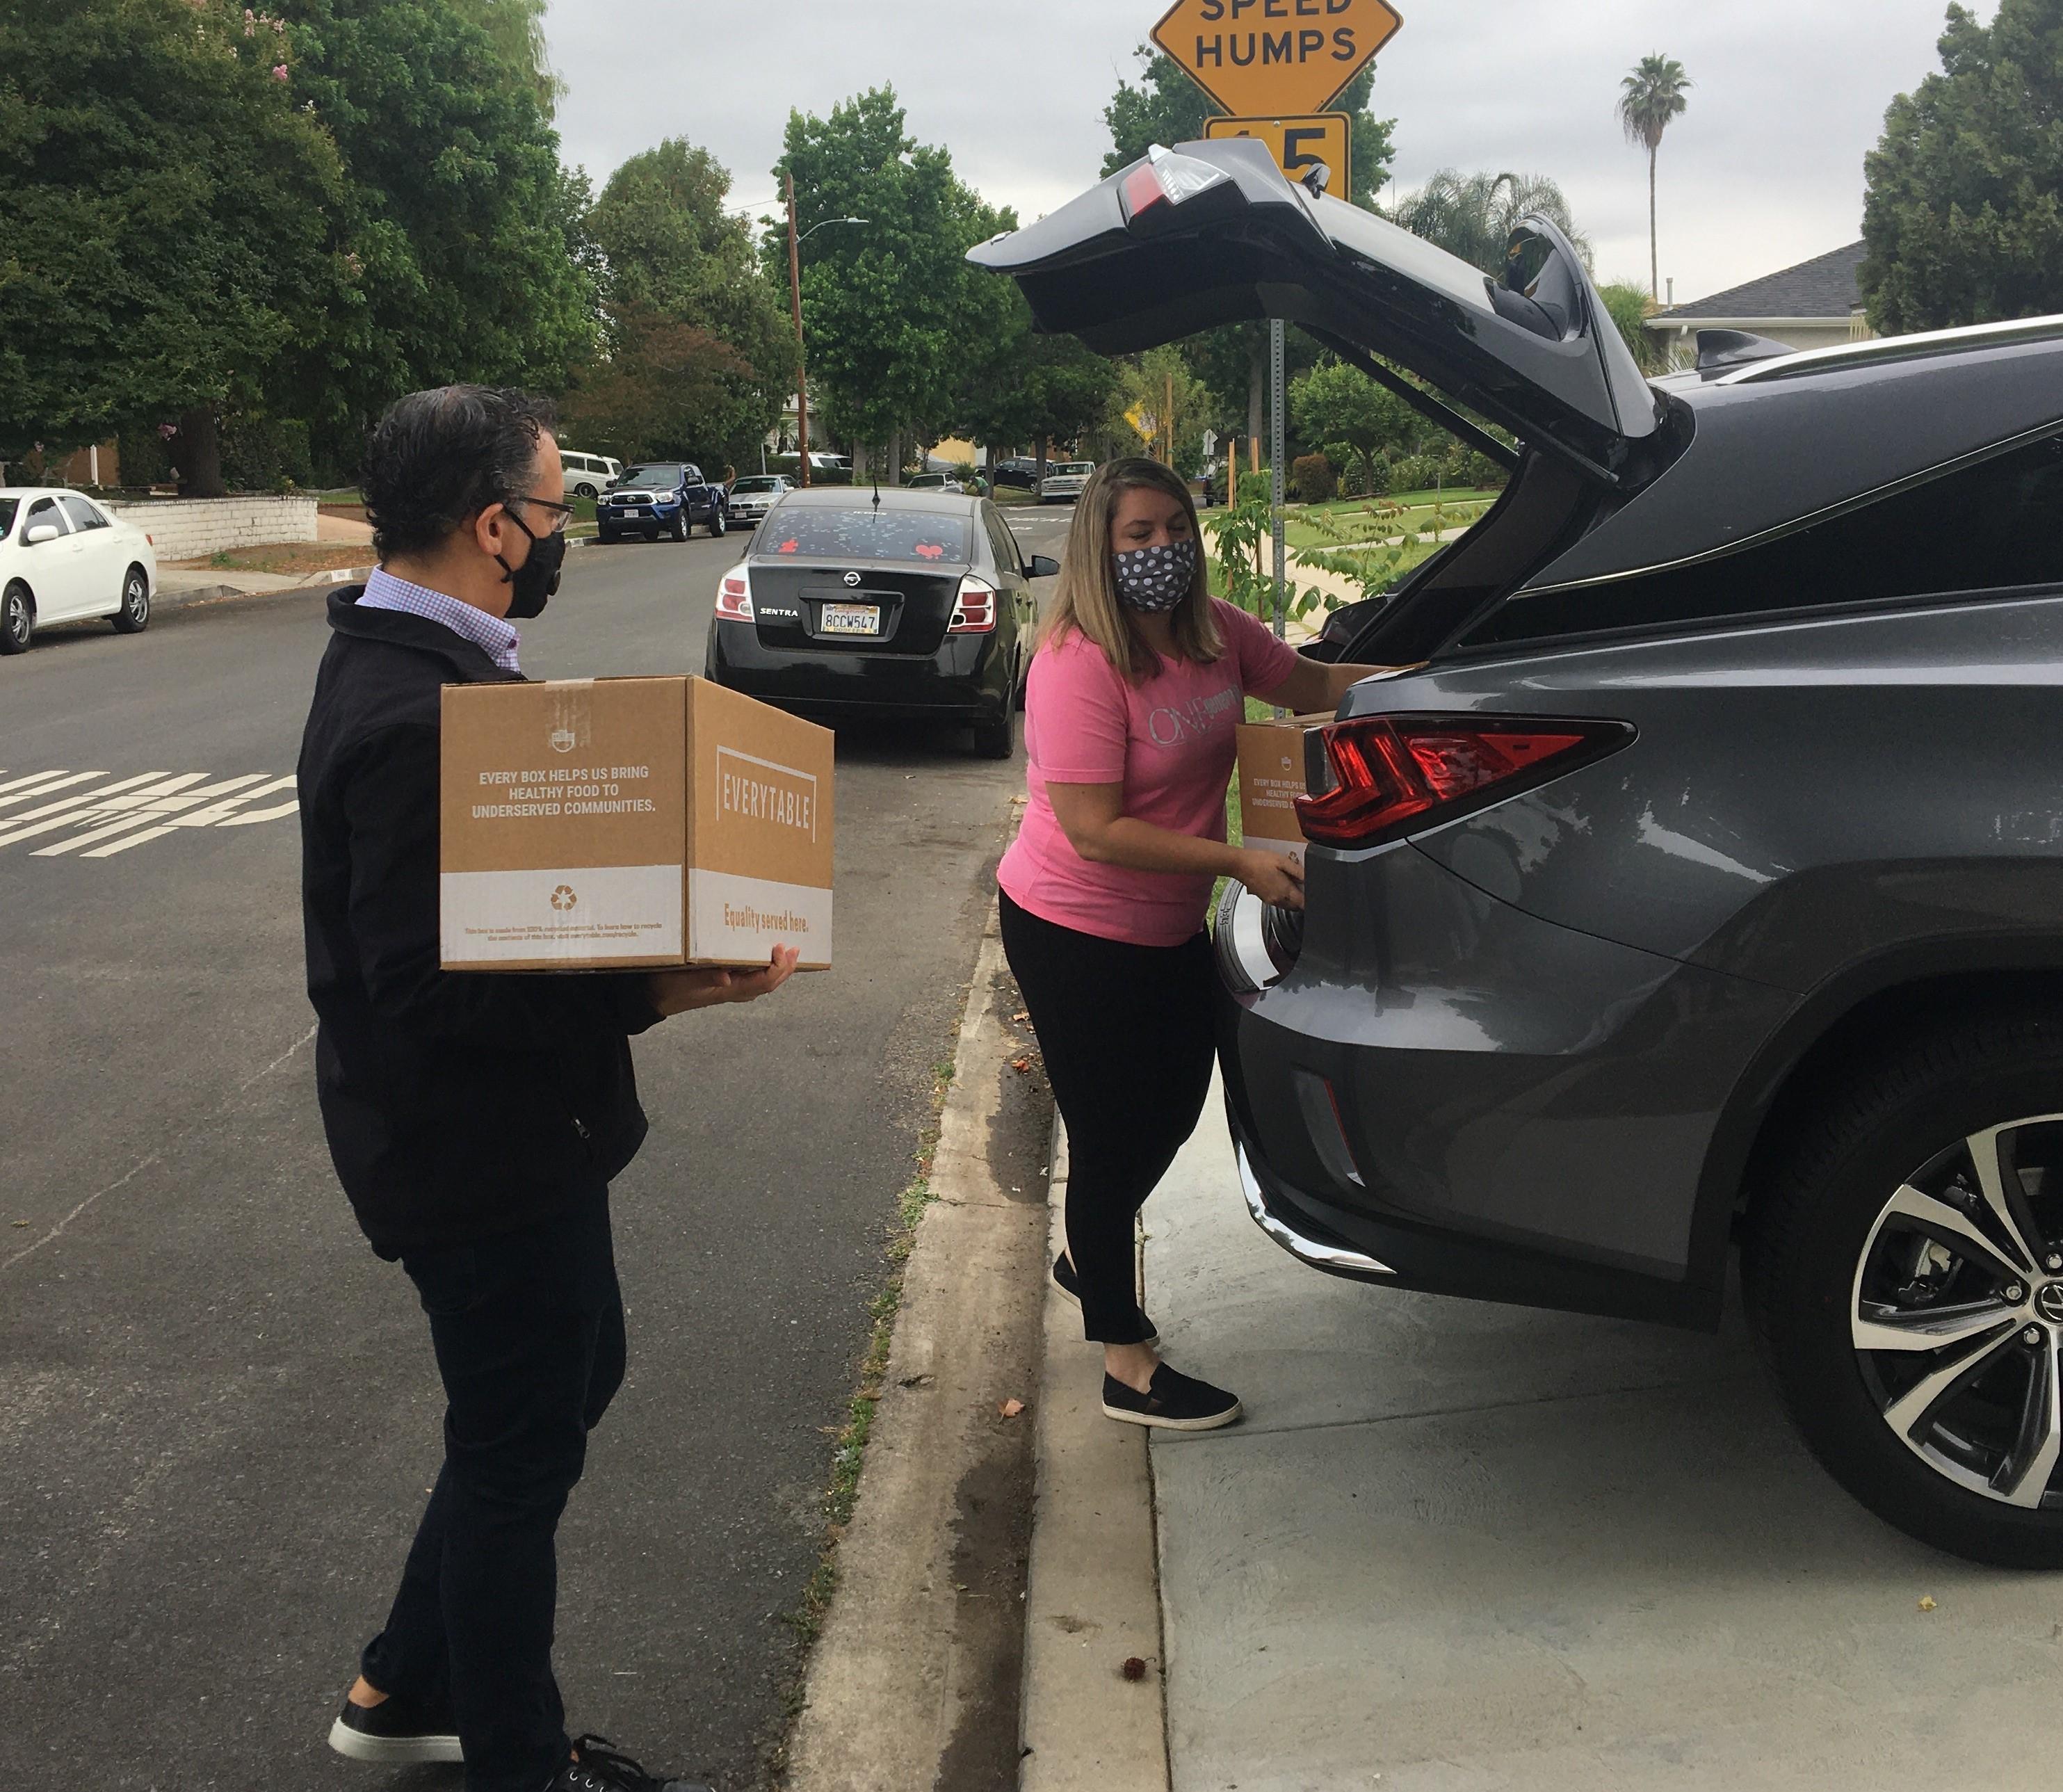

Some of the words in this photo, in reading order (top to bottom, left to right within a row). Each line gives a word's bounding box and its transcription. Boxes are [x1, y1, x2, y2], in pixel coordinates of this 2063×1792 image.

[1196, 27, 1357, 68] HUMPS
[759, 608, 798, 617] SENTRA
[825, 614, 875, 629] 8CCW547
[480, 771, 518, 784] EVERY
[522, 770, 547, 783] BOX
[549, 768, 588, 782] HELPS
[592, 767, 608, 780] US
[611, 765, 649, 779] BRING
[509, 786, 564, 800] HEALTHY
[567, 784, 600, 798] FOOD
[602, 784, 619, 796] TO
[724, 773, 810, 830] EVERYTABLE
[472, 802, 560, 818] UNDERSERVED
[564, 799, 656, 815] COMMUNITIES.
[725, 902, 759, 933] Equality
[761, 910, 788, 931] served
[789, 910, 809, 933] here.
